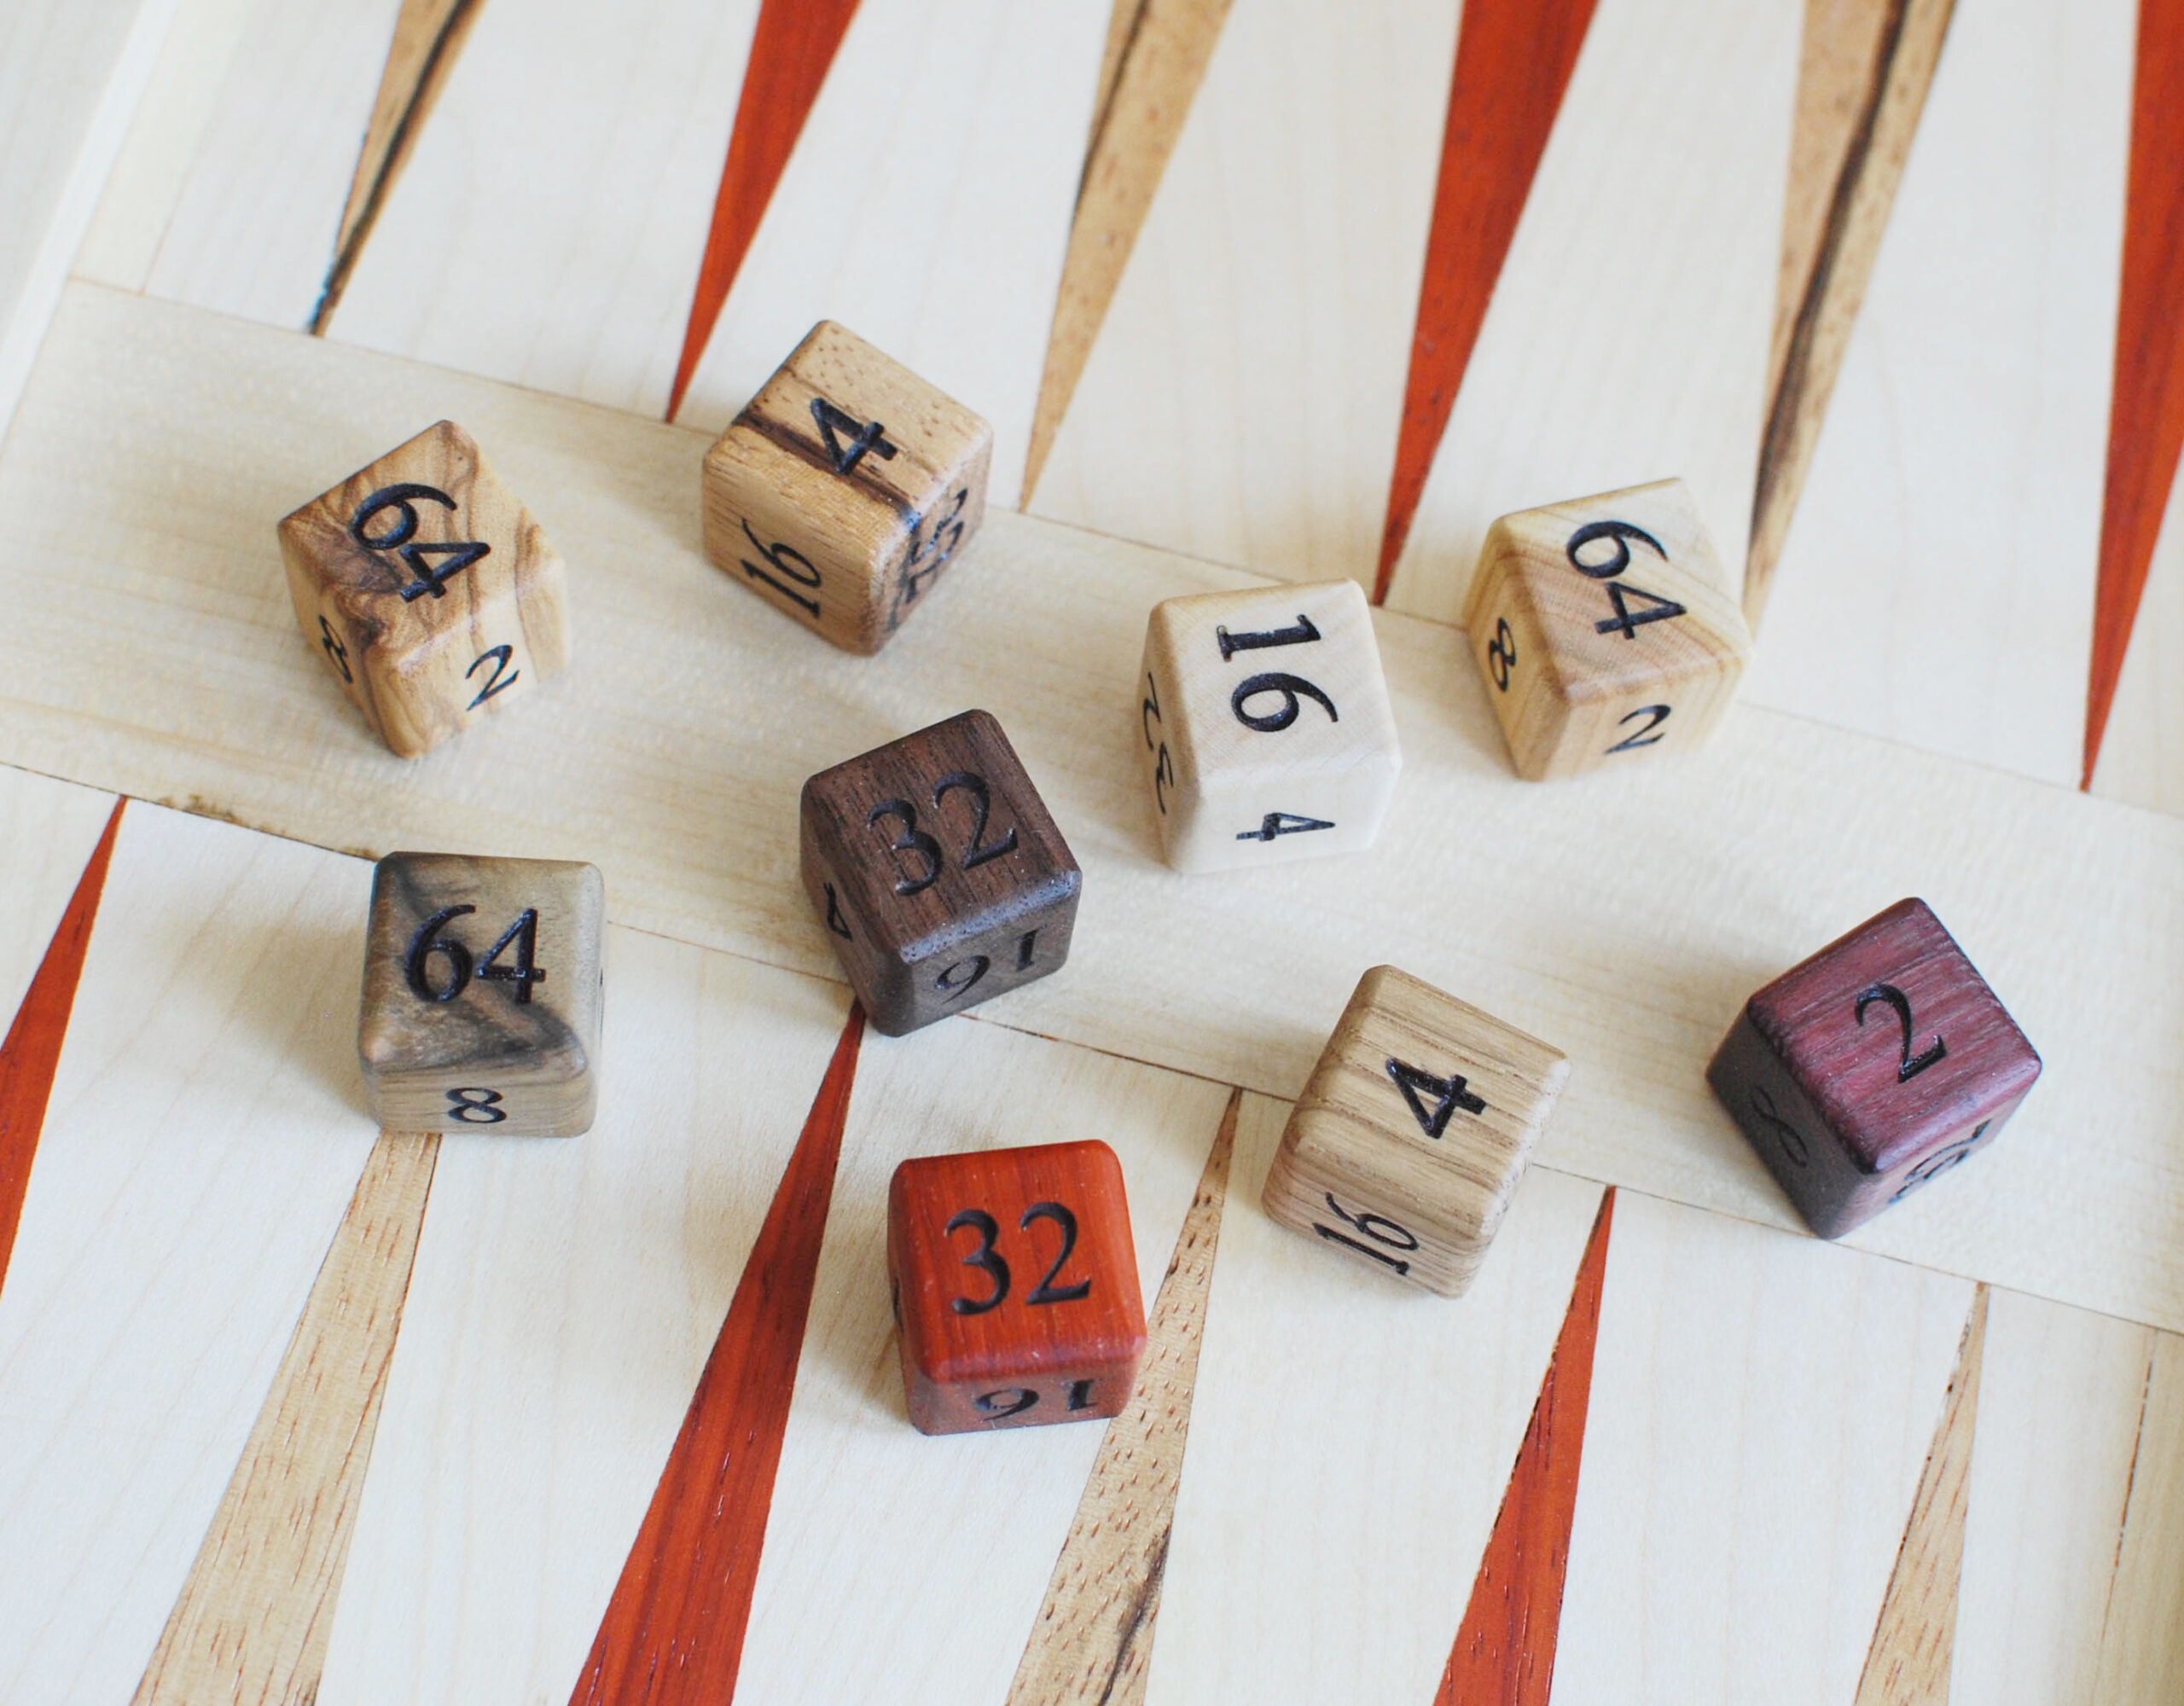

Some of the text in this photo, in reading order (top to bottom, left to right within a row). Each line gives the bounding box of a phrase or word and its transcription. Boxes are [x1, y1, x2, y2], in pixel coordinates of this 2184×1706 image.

[810, 397, 898, 475] 4
[351, 483, 491, 603] 64
[741, 518, 822, 618] 16
[1566, 520, 1687, 640] 64
[465, 645, 520, 711] 2
[1217, 614, 1339, 732] 16
[1489, 617, 1516, 693] 8
[1143, 672, 1174, 815] 32
[1603, 704, 1672, 755] 2
[867, 771, 1019, 897] 32
[1236, 812, 1336, 842] 4
[404, 903, 546, 1004] 64
[822, 882, 853, 943] 4
[934, 923, 1048, 1005] 16
[1855, 983, 1949, 1084] 2
[445, 1087, 507, 1123] 8
[1385, 1056, 1487, 1140] 4
[1751, 1085, 1809, 1168] 8
[944, 1201, 1092, 1315] 32
[1312, 1192, 1420, 1276] 16
[974, 1379, 1100, 1422] 16
